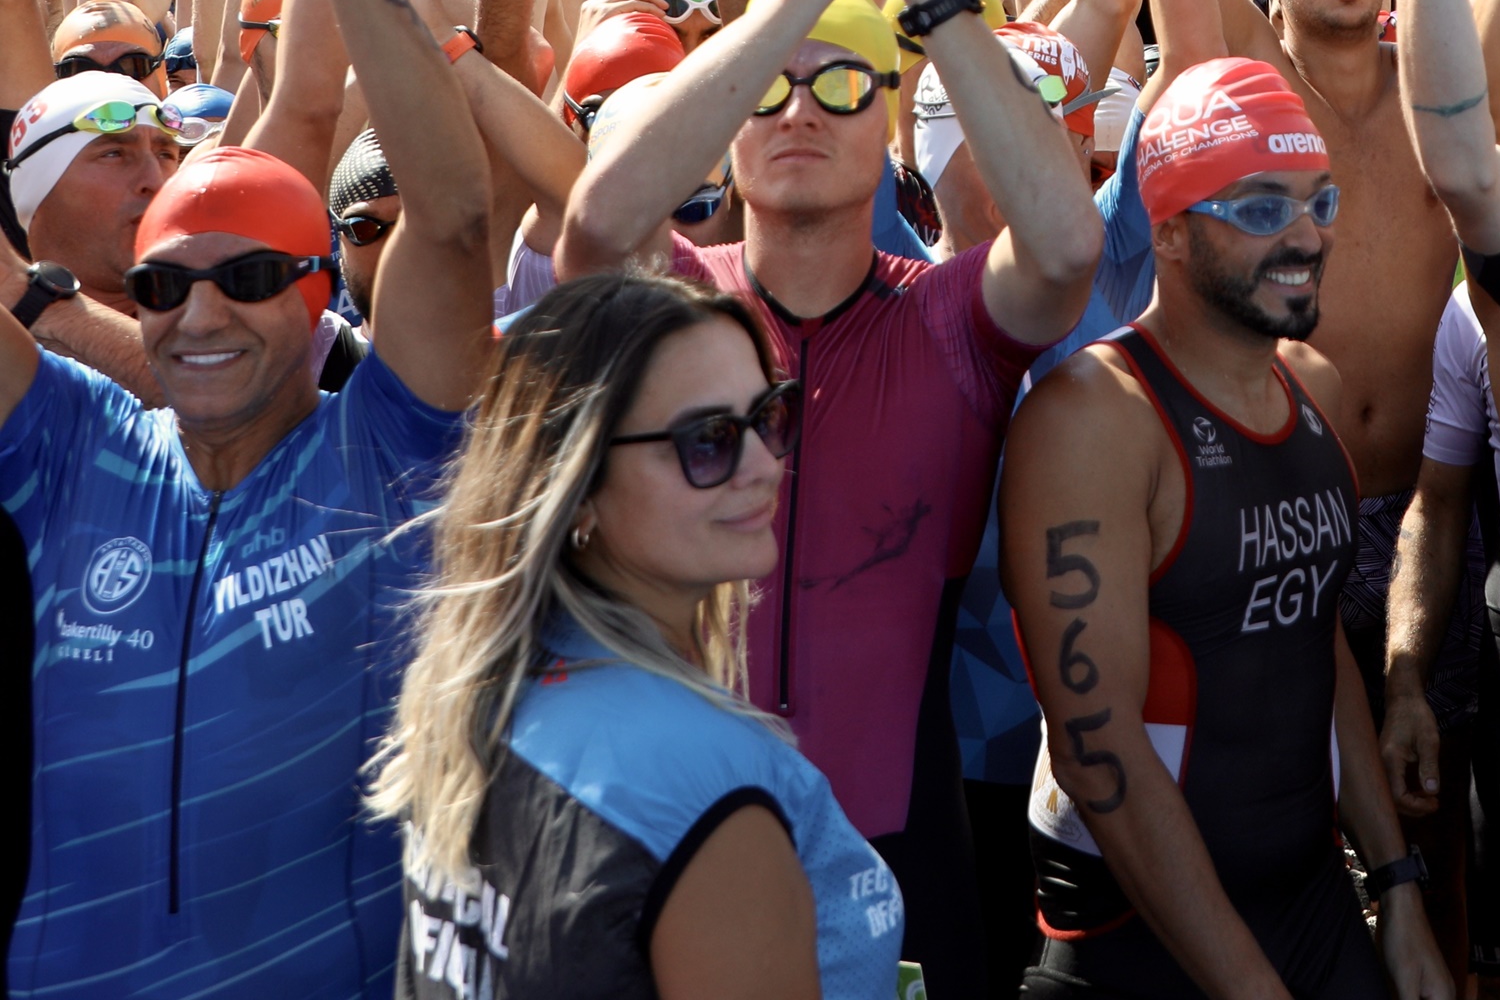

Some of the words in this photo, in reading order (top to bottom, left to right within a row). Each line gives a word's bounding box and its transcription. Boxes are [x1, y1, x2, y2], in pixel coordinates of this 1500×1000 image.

[1021, 35, 1058, 57] TRI
[1141, 90, 1242, 136] QUA
[1137, 114, 1253, 173] HALLENGE
[1165, 151, 1180, 162] OF
[1180, 129, 1259, 157] CHAMPIONS
[1195, 455, 1232, 467] Triathlon
[1198, 443, 1225, 455] World
[1238, 486, 1353, 574] HASSAN
[1241, 556, 1341, 634] EGY
[126, 629, 155, 650] 40
[254, 598, 314, 650] TUR
